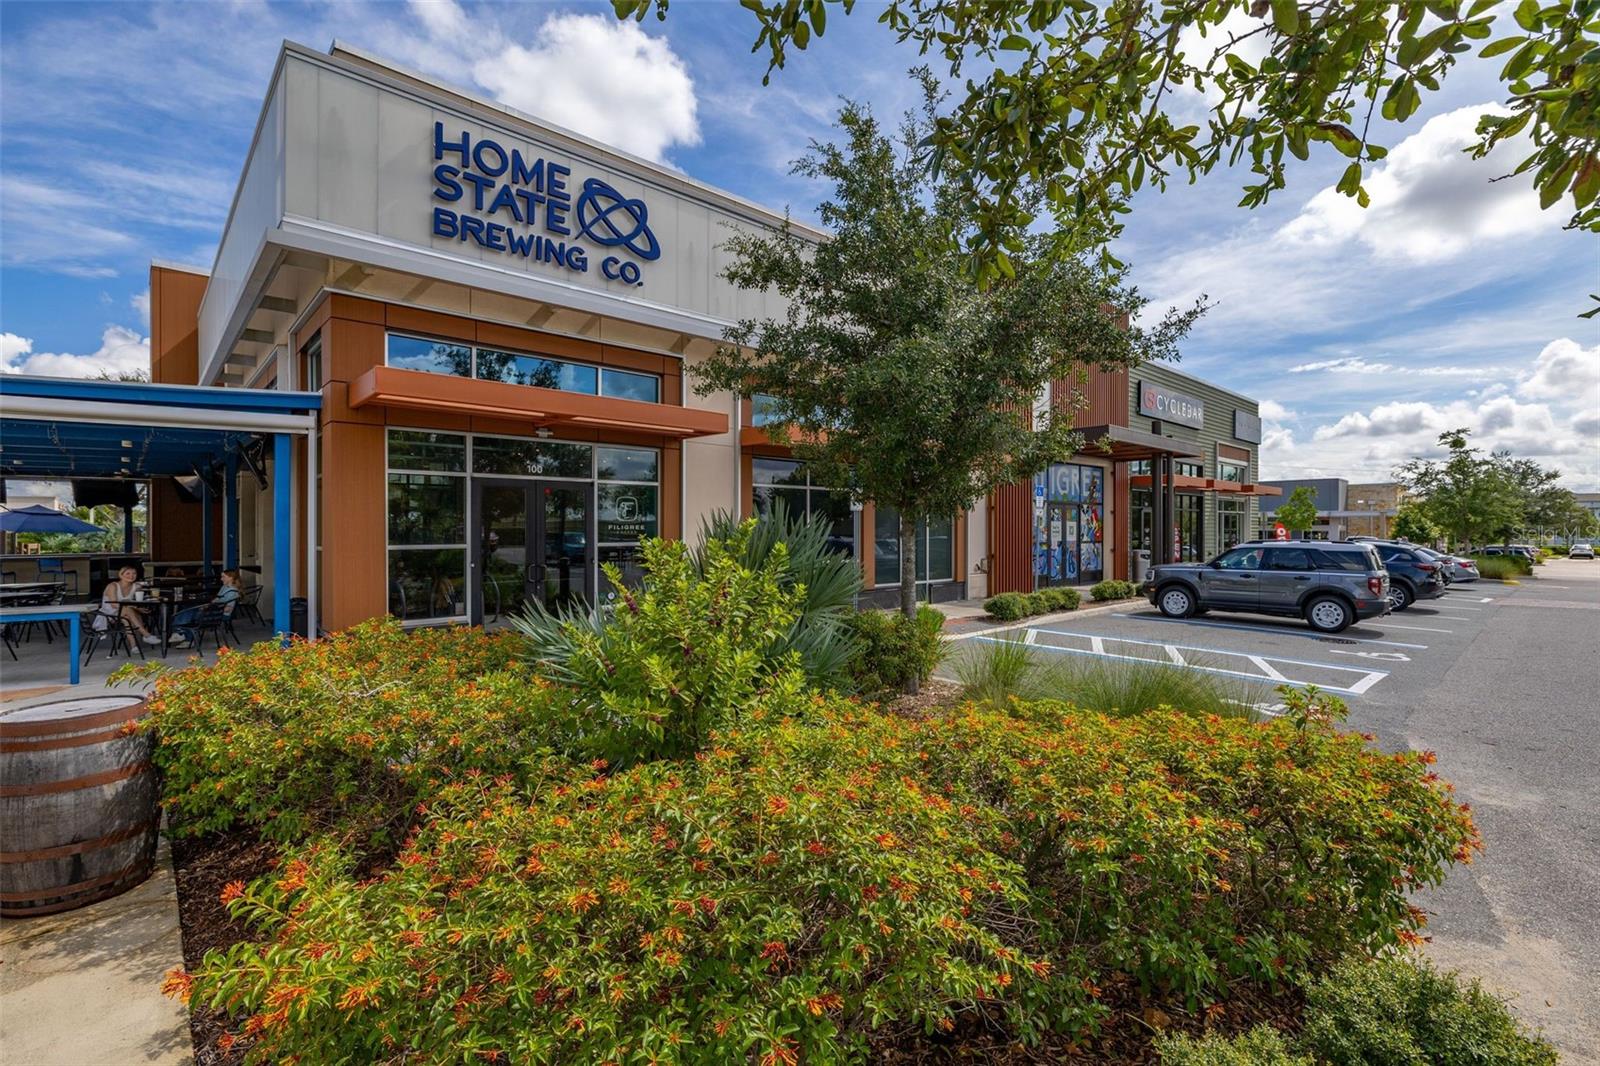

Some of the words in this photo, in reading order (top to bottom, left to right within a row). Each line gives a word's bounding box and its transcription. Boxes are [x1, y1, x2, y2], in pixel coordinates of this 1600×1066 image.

[434, 121, 571, 201] HOME
[434, 164, 571, 236] STATE
[434, 207, 588, 272] BREWING
[602, 256, 643, 287] CO.
[1156, 395, 1203, 421] CYCLEBAR
[527, 465, 543, 474] 100
